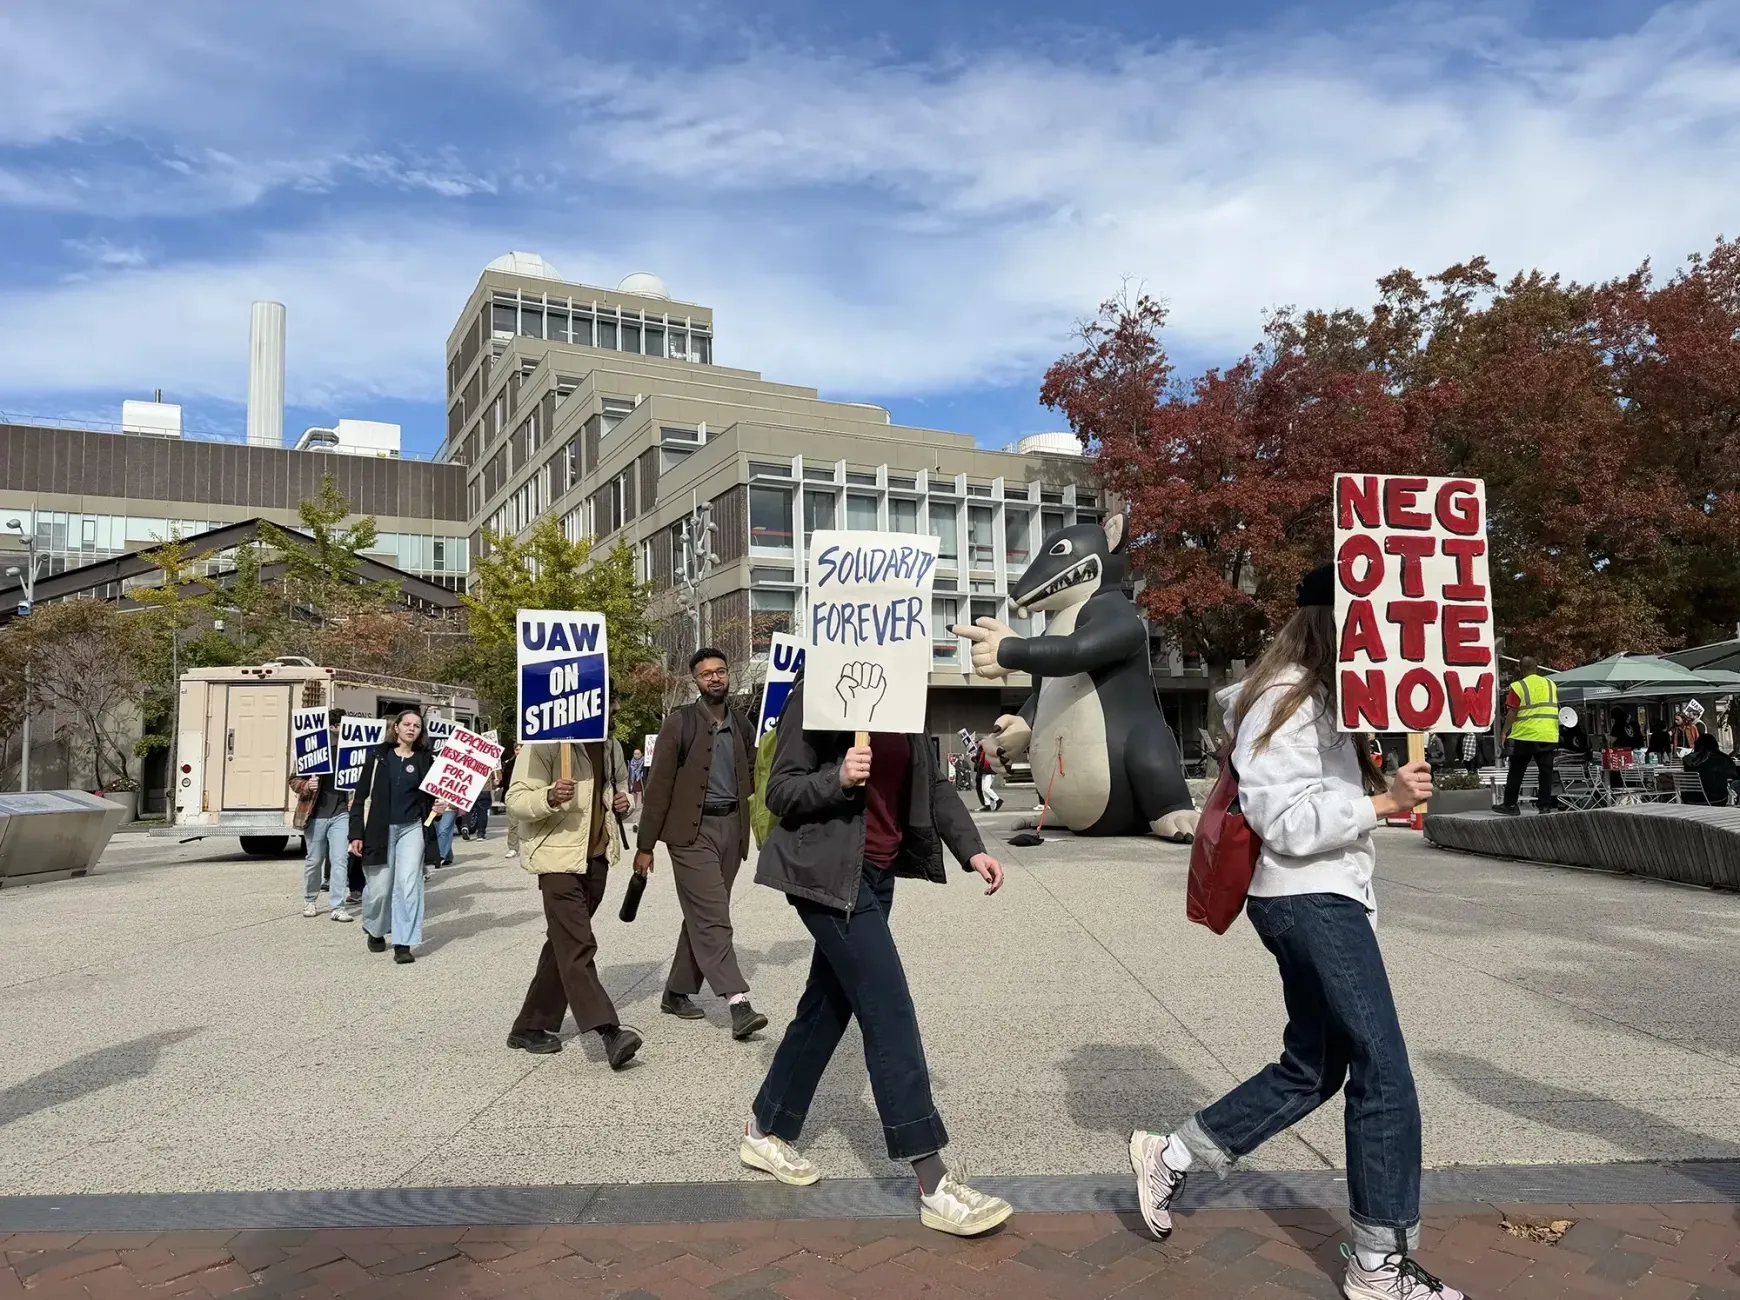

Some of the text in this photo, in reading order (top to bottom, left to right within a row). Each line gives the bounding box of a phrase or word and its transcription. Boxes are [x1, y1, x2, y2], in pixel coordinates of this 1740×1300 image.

[1337, 476, 1480, 536] NEG
[818, 545, 936, 588] SOLIDARITY
[1337, 534, 1486, 601] OTI
[812, 596, 926, 647] FOREVER
[1339, 599, 1492, 666] ATE
[522, 622, 600, 652] UAW
[773, 643, 806, 674] UA
[549, 662, 580, 696] ON
[525, 687, 602, 736] STRIKE
[1340, 667, 1494, 731] NOW
[294, 713, 325, 731] UAW
[342, 723, 383, 742] UAW
[305, 734, 318, 752] ON
[350, 748, 367, 767] ON
[453, 729, 502, 759] TEACHERS
[298, 746, 329, 772] STRIKE
[338, 766, 363, 786] STRI
[439, 776, 468, 796] FAIR
[443, 764, 473, 785] FOR A
[425, 782, 472, 808] CONTRACT
